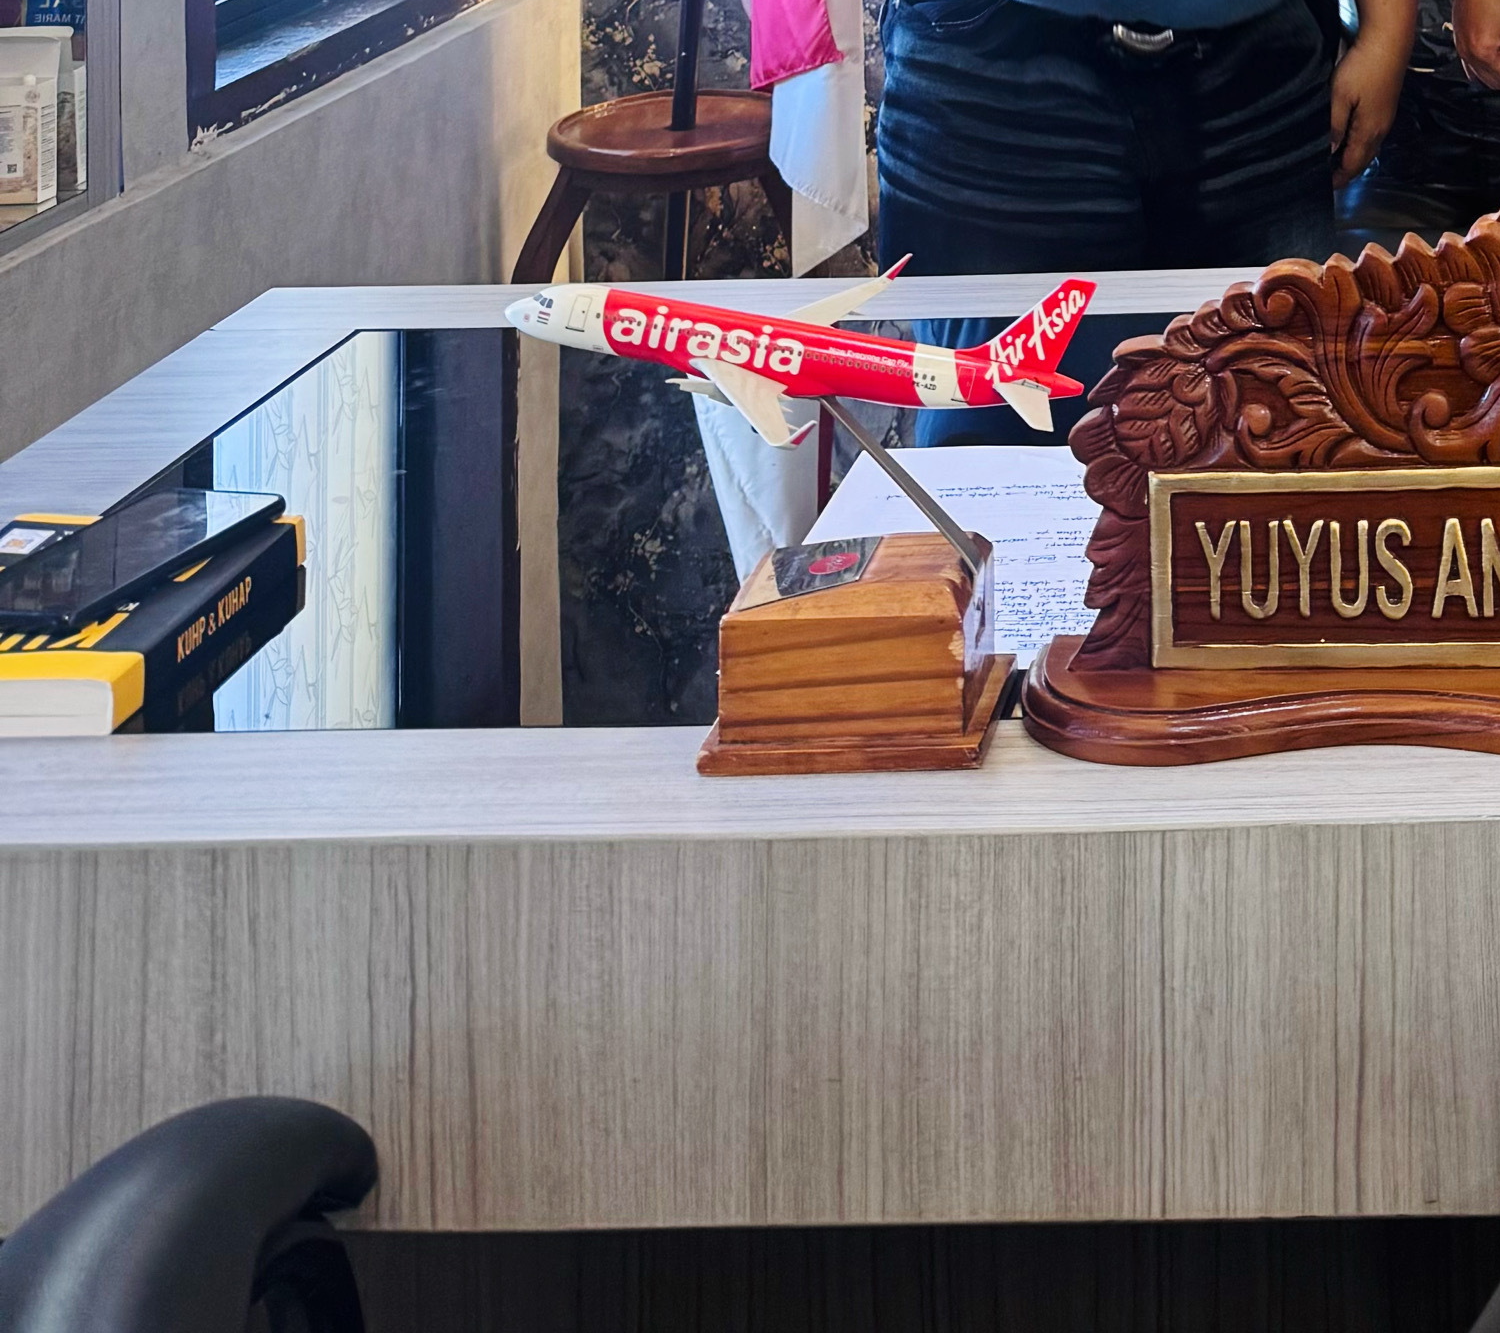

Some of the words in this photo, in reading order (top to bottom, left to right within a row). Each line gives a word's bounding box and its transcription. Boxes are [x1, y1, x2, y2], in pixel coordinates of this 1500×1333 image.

[610, 305, 805, 376] airasia
[1195, 519, 1413, 619] YUYUS
[177, 616, 206, 663] KUHP
[207, 612, 216, 636] &
[217, 576, 252, 627] KUHAP
